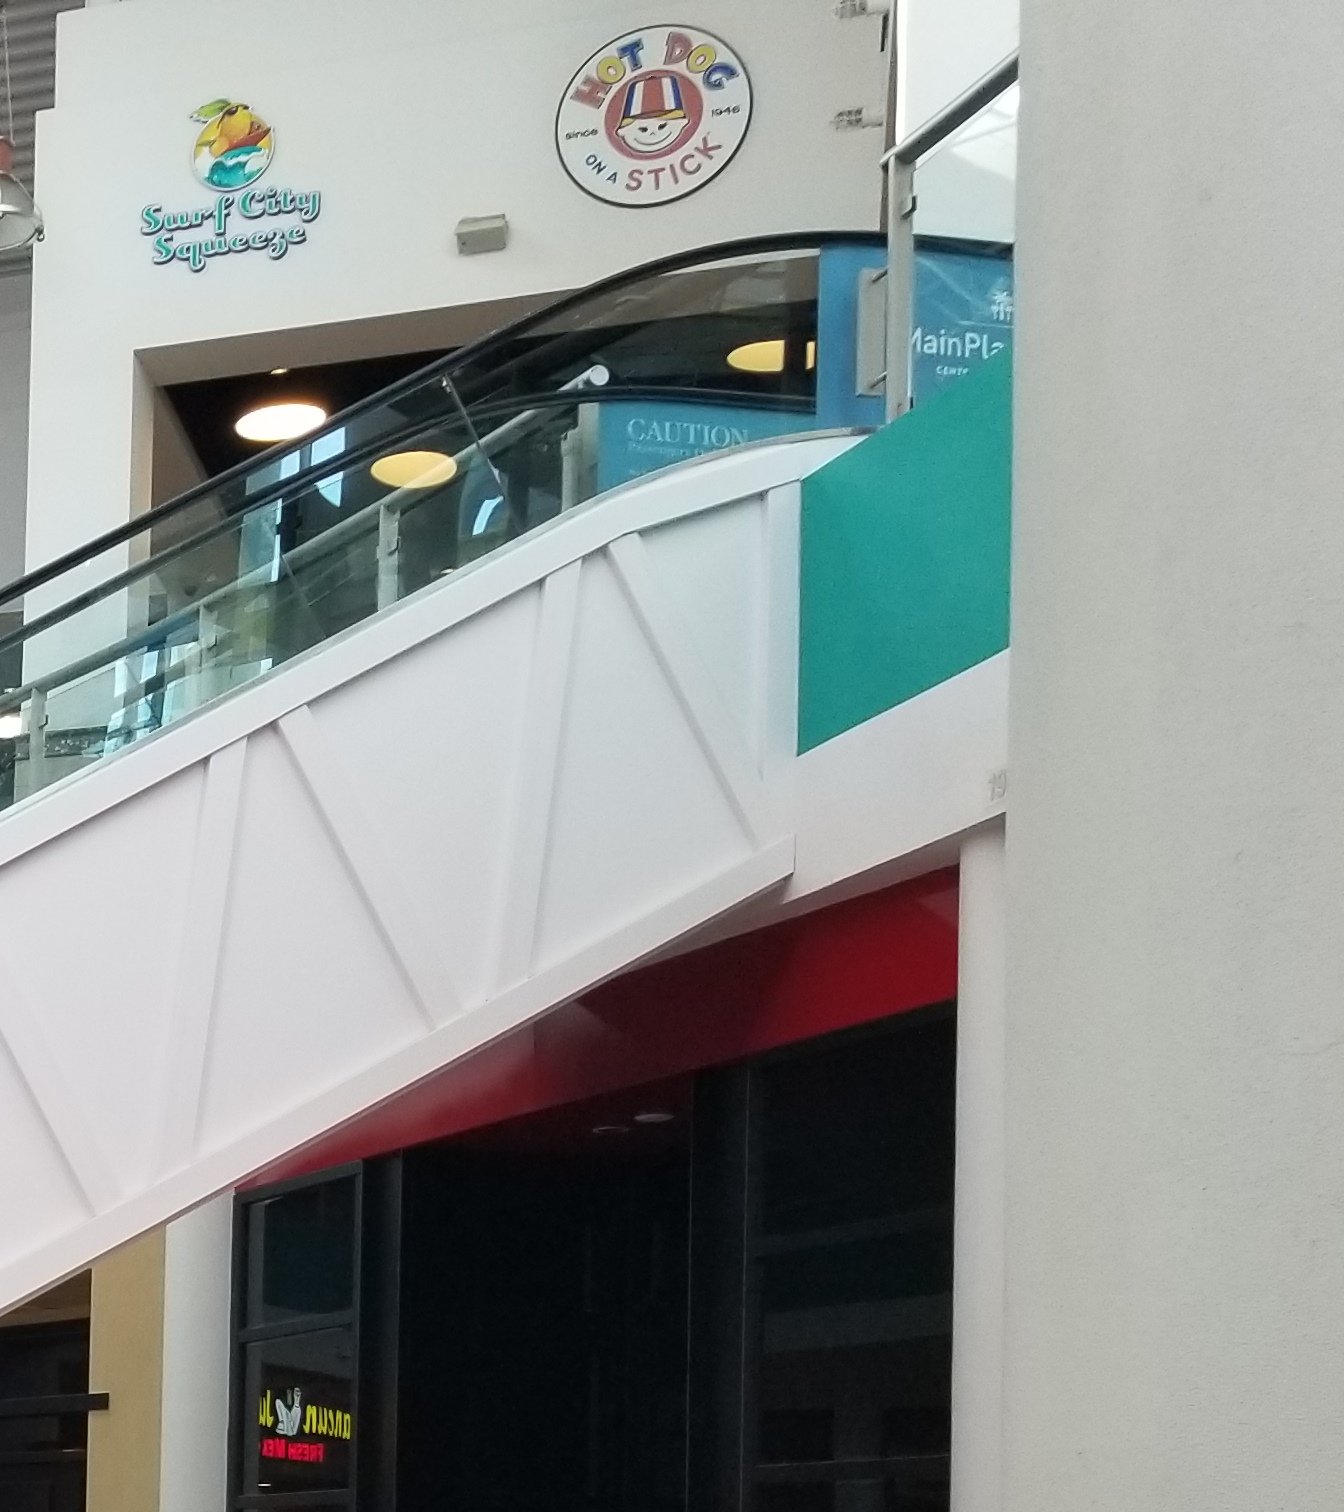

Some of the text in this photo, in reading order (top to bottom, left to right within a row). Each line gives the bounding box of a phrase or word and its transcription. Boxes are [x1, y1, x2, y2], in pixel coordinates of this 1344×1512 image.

[570, 31, 739, 110] HOT DOG
[585, 132, 723, 192] ON A STICK
[140, 184, 322, 237] Surf City
[152, 224, 308, 273] Squeeze
[626, 417, 750, 448] CAUTION
